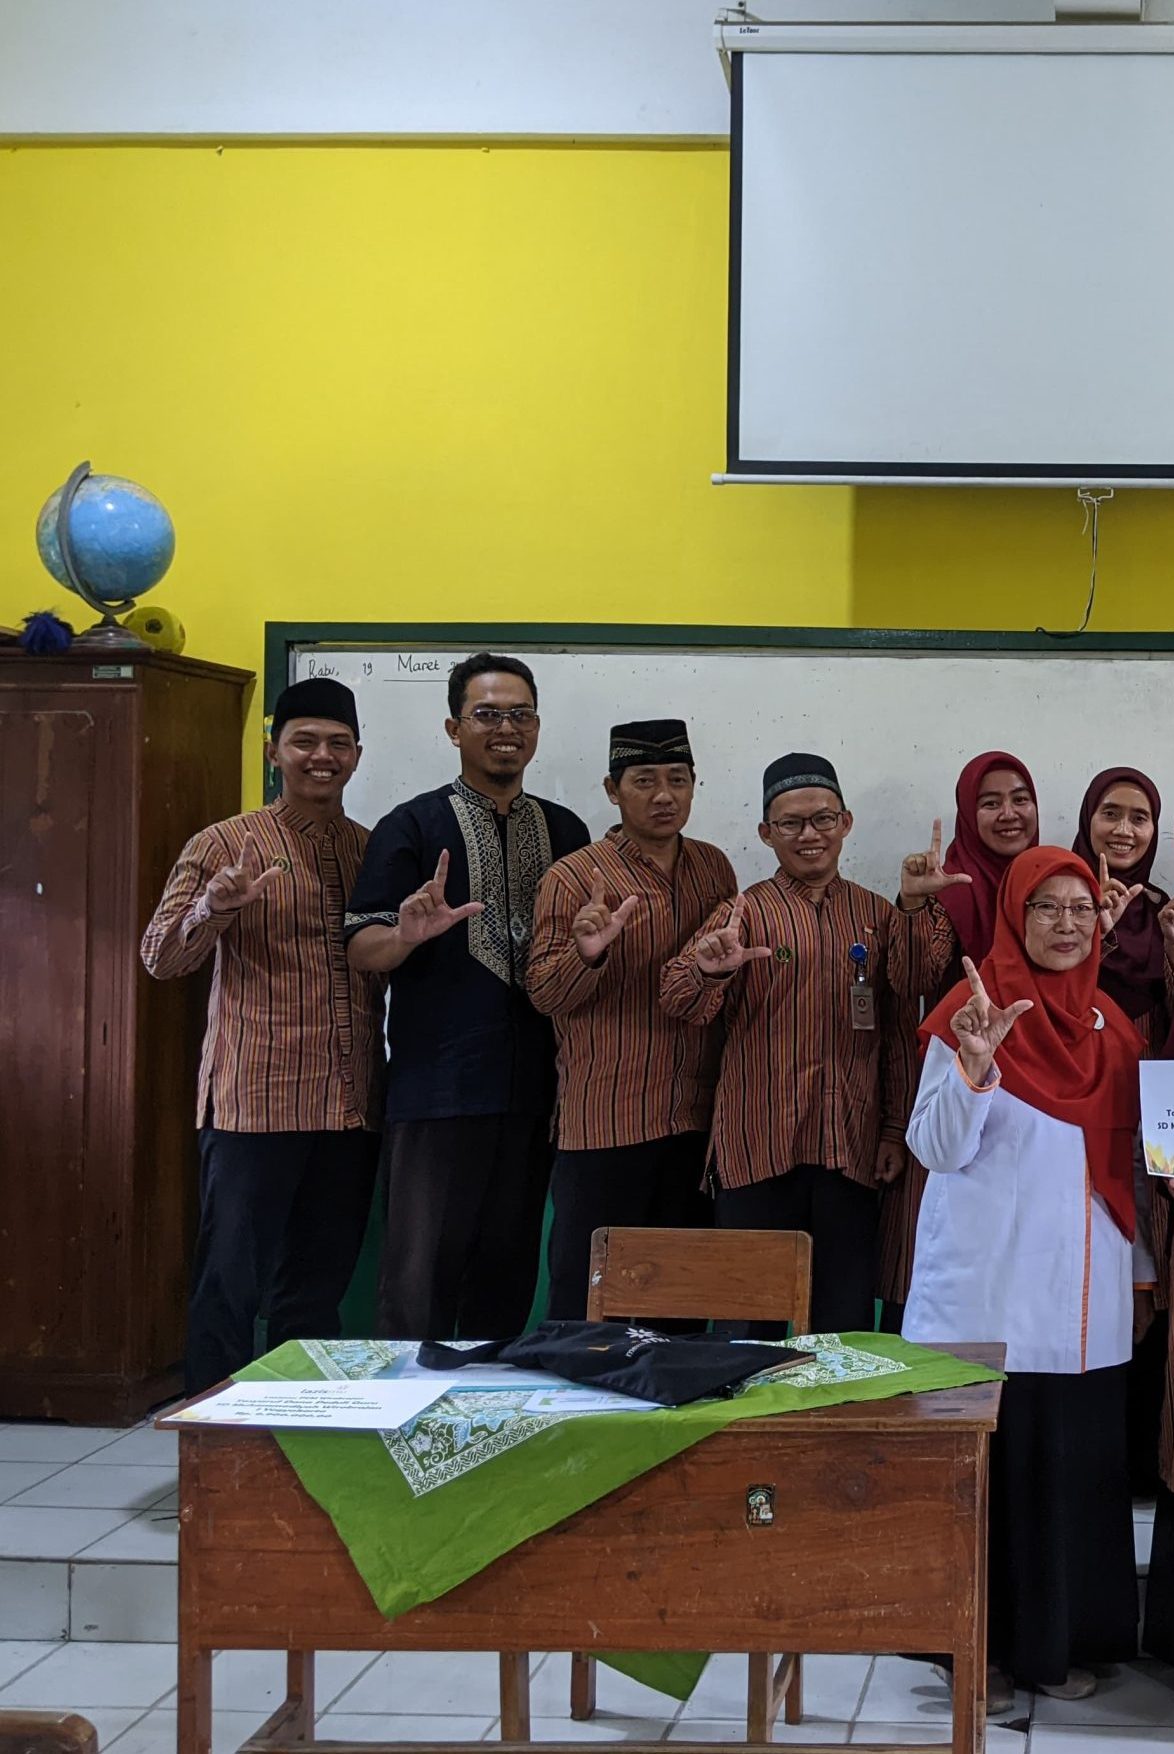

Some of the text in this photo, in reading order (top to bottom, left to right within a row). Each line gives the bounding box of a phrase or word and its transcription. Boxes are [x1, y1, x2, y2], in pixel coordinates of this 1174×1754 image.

[362, 662, 373, 676] 19
[397, 654, 440, 672] Maret
[1157, 1122, 1169, 1130] SD
